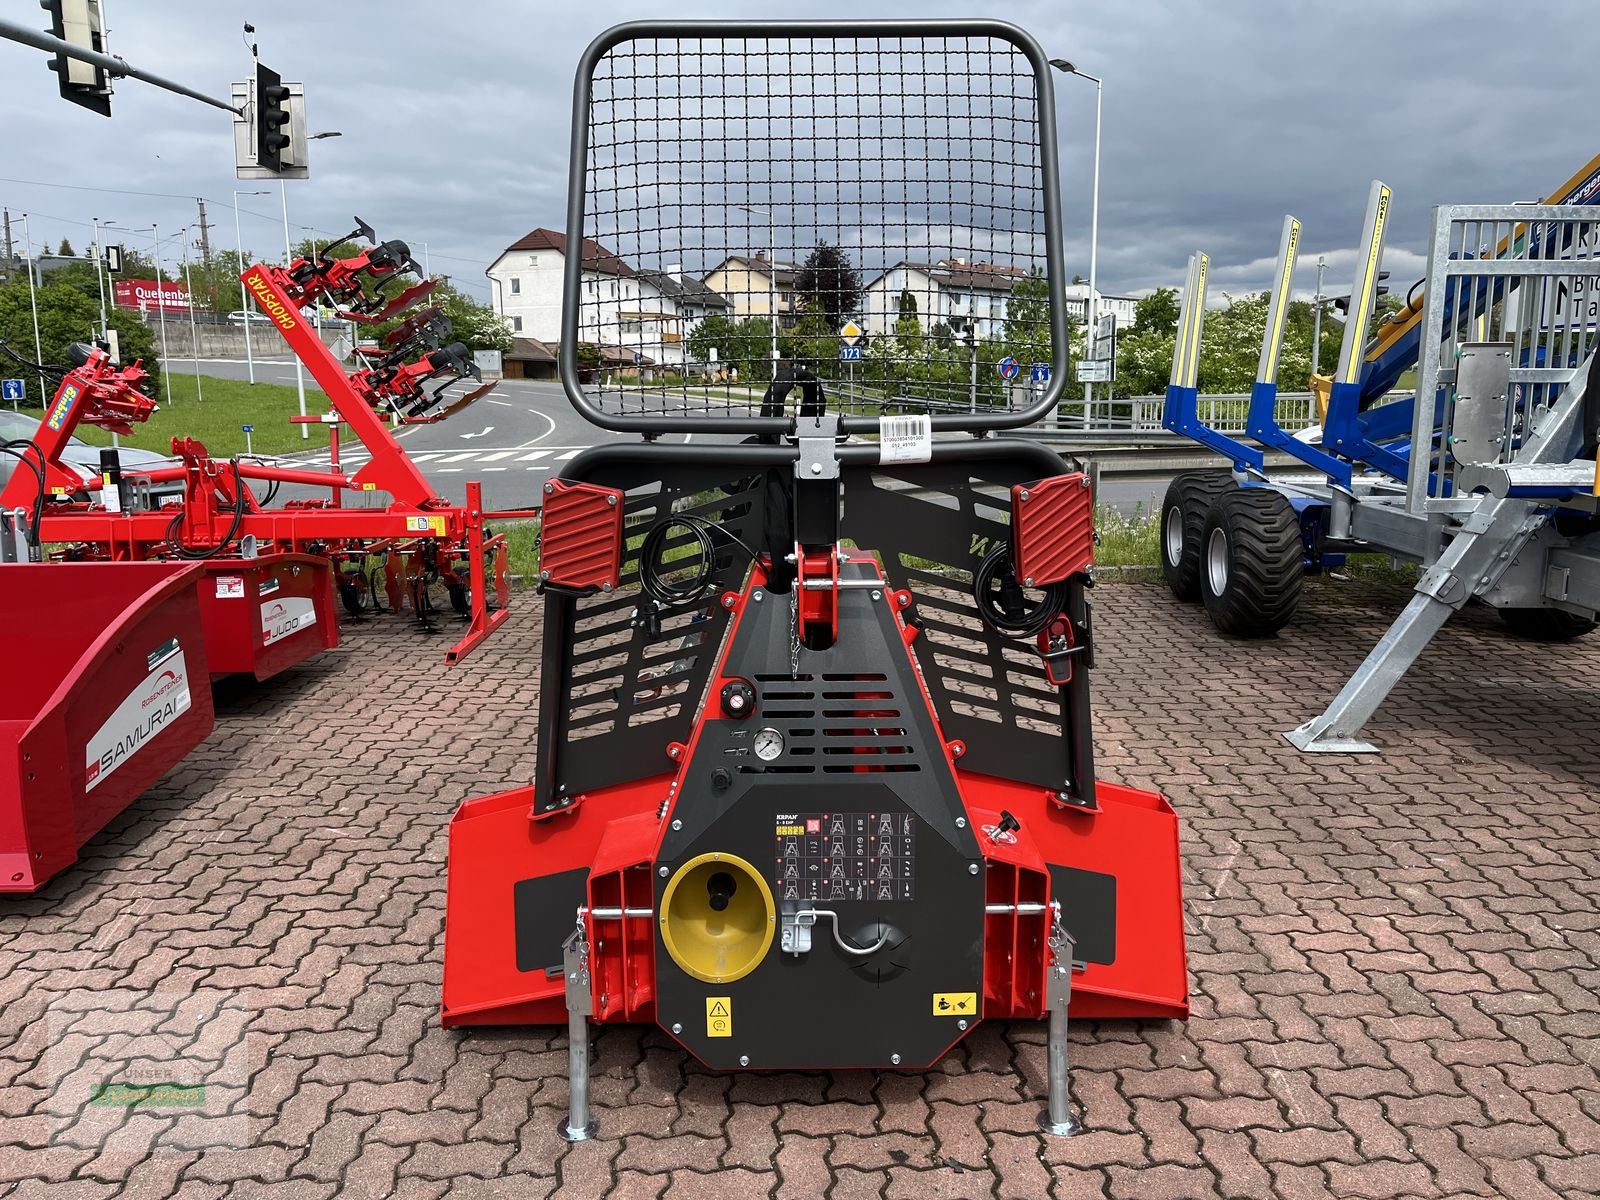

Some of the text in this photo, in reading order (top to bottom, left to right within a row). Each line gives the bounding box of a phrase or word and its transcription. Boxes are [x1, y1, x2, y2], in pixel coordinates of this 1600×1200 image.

[135, 286, 191, 300] Quehenbe
[247, 273, 296, 329] CHOPSTAR
[843, 348, 860, 359] 123
[272, 617, 299, 639] JUDO
[141, 673, 183, 709] ROSENSTEINER
[100, 697, 178, 773] SAMURAI
